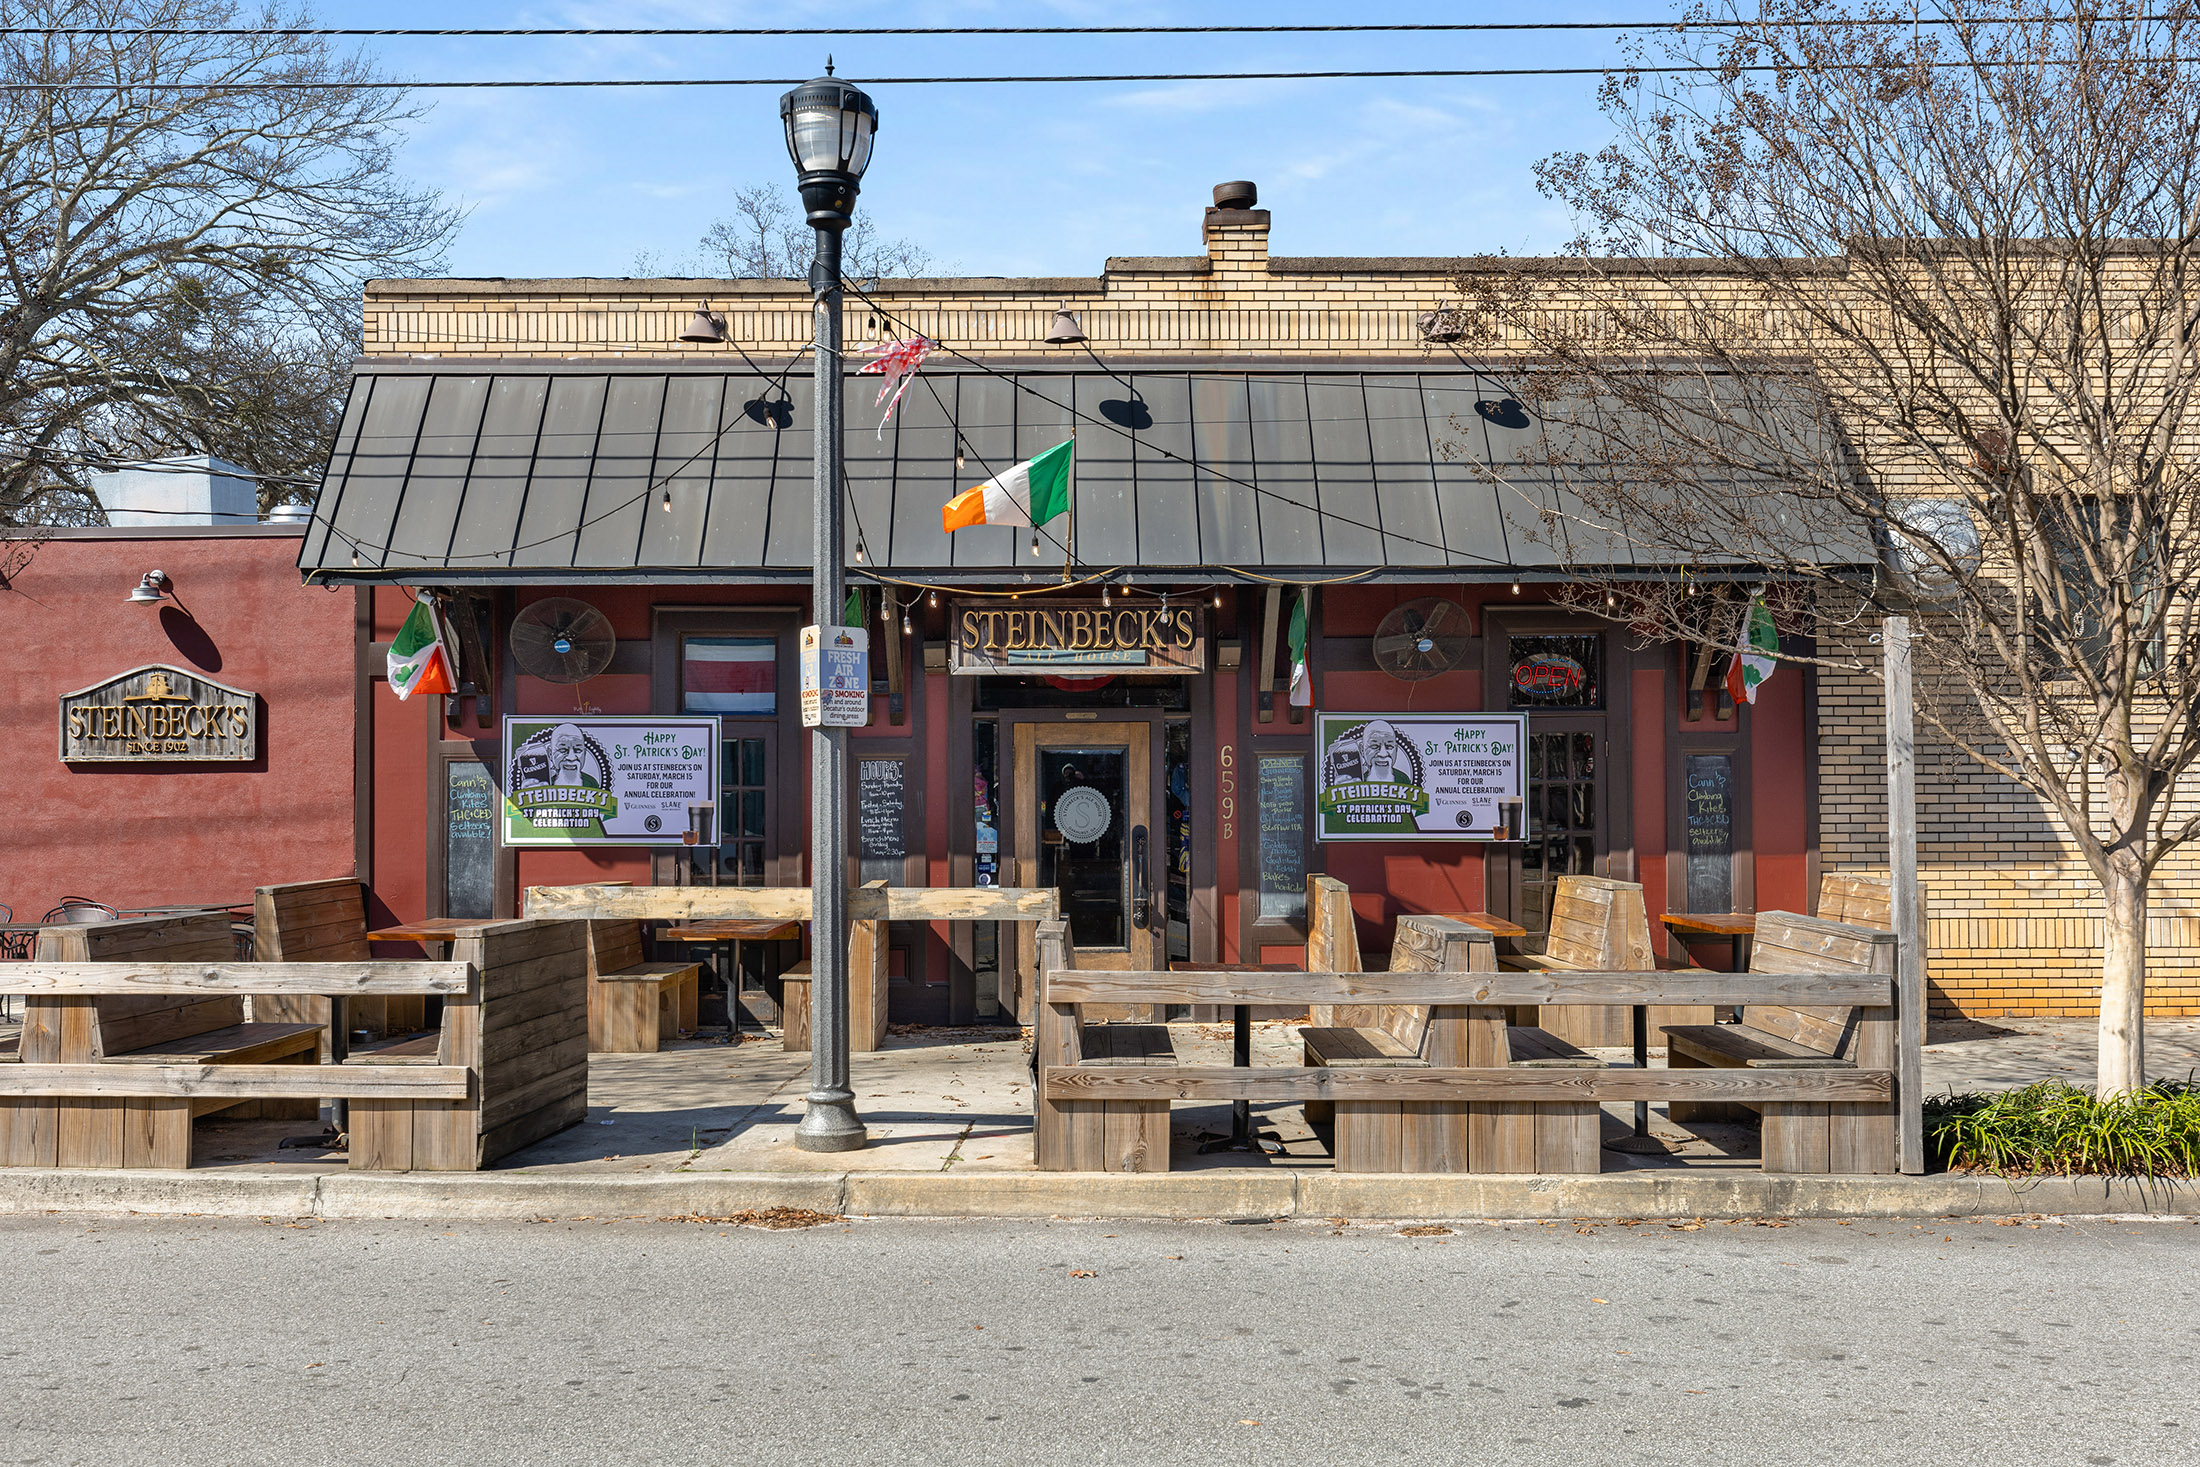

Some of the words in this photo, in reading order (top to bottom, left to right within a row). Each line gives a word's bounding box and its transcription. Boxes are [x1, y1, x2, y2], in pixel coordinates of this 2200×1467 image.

[962, 610, 1194, 650] STEINBECK'S
[828, 651, 860, 664] FRESH
[1024, 652, 1056, 662] ALE
[1074, 651, 1132, 662] HOUSE
[835, 664, 854, 676] AIR
[1516, 666, 1581, 687] OPEN
[68, 705, 248, 738] STEINBECK'S
[644, 732, 676, 745] HAPPY
[1454, 728, 1486, 741] HAPPY
[127, 742, 160, 752] SINCE
[164, 742, 187, 752] 1902
[614, 744, 630, 759] ST.
[634, 744, 678, 758] PATRICK'S
[682, 745, 706, 760] DAY!
[1425, 741, 1441, 756] ST.
[1444, 741, 1488, 755] PATRICK'S
[1491, 741, 1514, 756] DAY!
[524, 762, 547, 773] GUINNESS
[1261, 759, 1302, 768] DRAFT
[1336, 759, 1359, 770] GUINNESS
[861, 760, 903, 781] HOURS:
[518, 788, 608, 806] STEINBECK'S
[1331, 784, 1420, 802] STEINBECK'S
[461, 800, 488, 809] Kites
[1337, 804, 1346, 813] ST
[1349, 804, 1392, 813] PATRICK'S
[1394, 804, 1411, 813] DAY
[523, 809, 533, 818] ST
[536, 809, 580, 818] PATRICK'S
[582, 809, 599, 818] DAY
[1075, 802, 1090, 828] S
[1346, 814, 1402, 823] CELEBRATION
[533, 818, 589, 828] CELEBRATION
